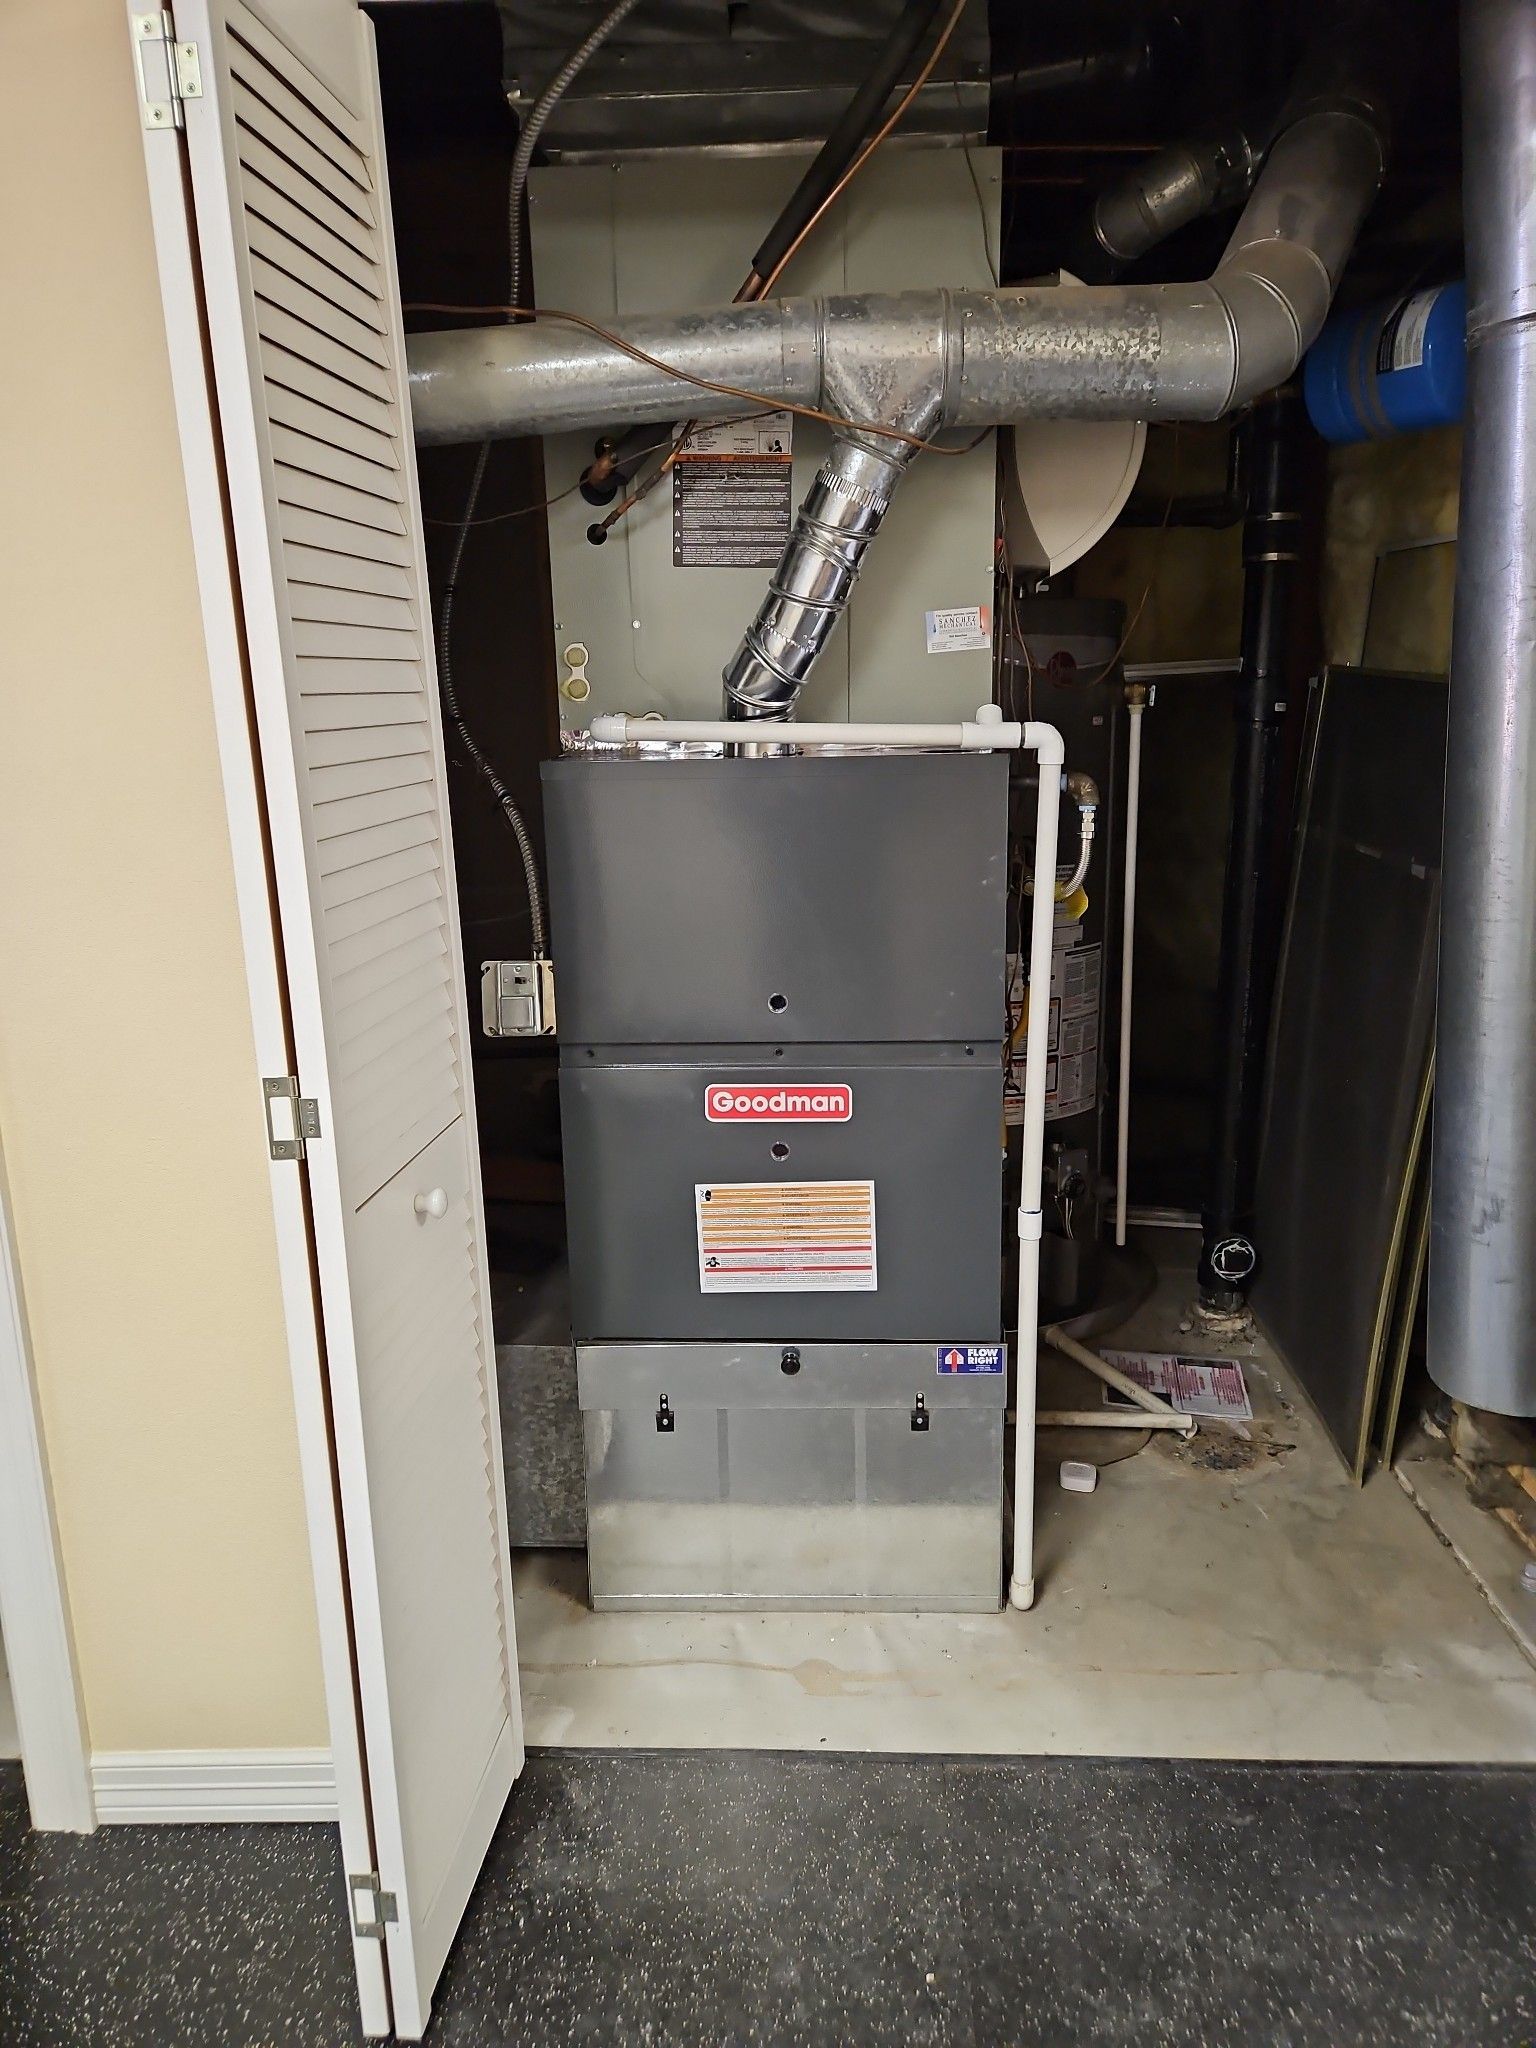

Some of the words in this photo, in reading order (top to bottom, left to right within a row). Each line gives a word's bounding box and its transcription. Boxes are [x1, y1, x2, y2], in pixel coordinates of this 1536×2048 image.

[938, 616, 976, 624] SANCHEZ
[712, 1091, 845, 1112] Goodman
[967, 1348, 998, 1356] FLOW
